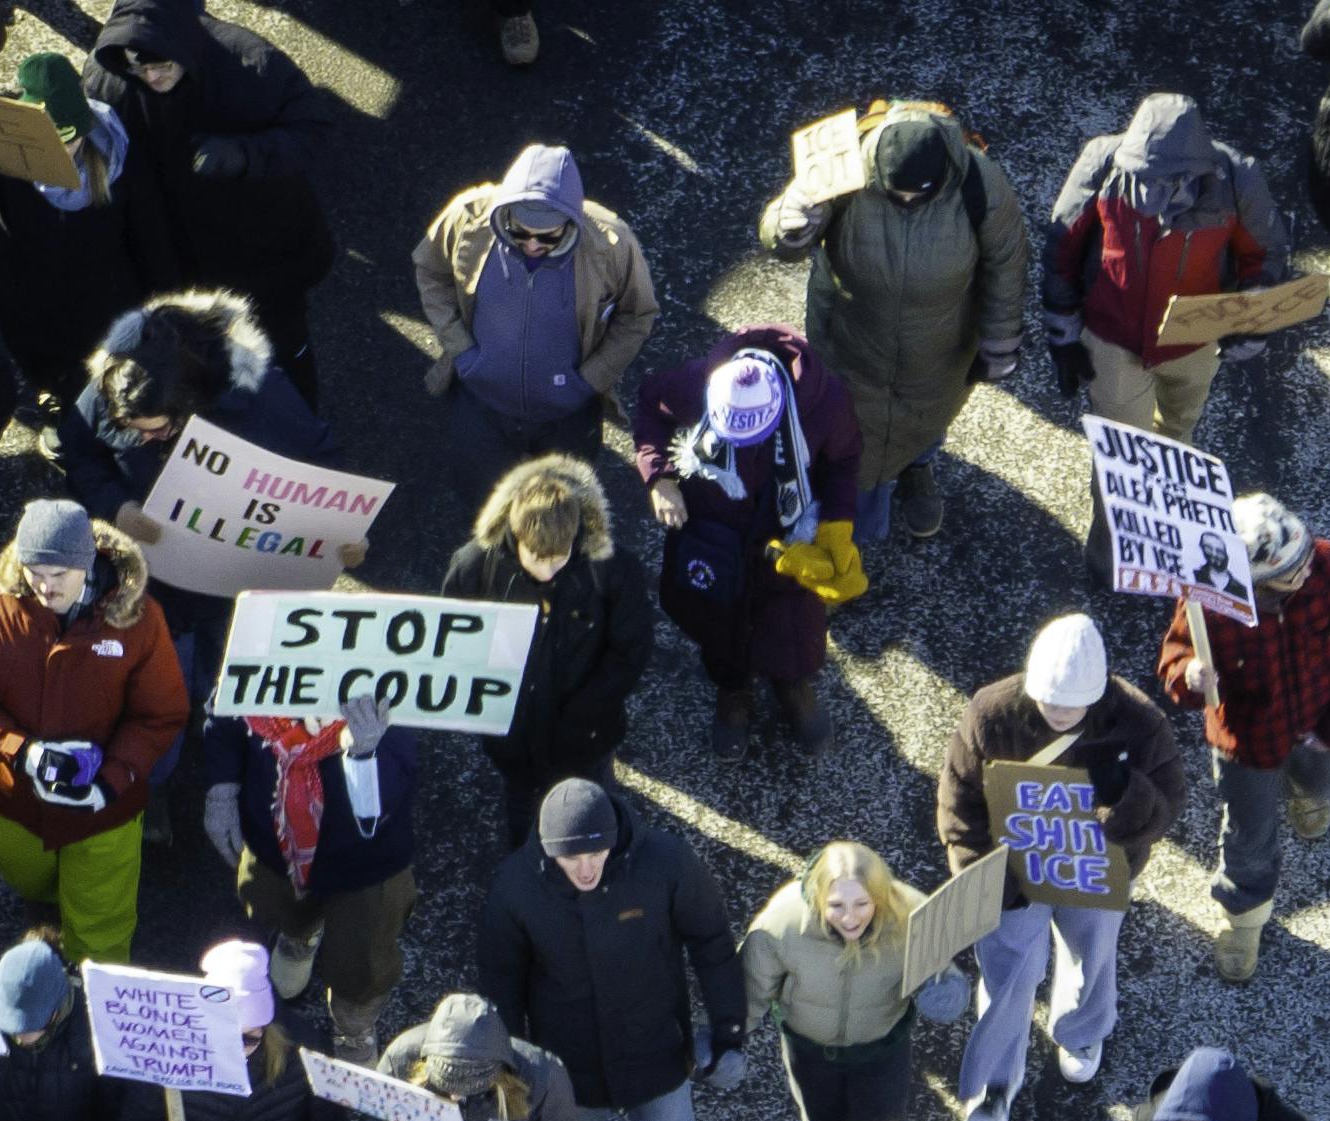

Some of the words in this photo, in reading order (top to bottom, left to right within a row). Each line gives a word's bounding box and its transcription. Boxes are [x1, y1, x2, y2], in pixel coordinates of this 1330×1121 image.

[804, 122, 846, 158] ICE
[181, 438, 231, 476] NO
[242, 467, 378, 516] HUMAN
[1097, 425, 1227, 497] JUSTICE
[242, 498, 281, 525] IS
[1106, 471, 1156, 511] ALEX
[169, 498, 326, 559] ILLEGAL
[1111, 506, 1183, 551] KILLED
[1163, 490, 1237, 535] PRETTI
[1119, 535, 1145, 566] BY
[1153, 546, 1185, 579] ICE
[281, 608, 484, 657] STOP
[227, 665, 324, 704] THE
[338, 668, 512, 716] COUP
[1017, 781, 1095, 813] EAT
[999, 813, 1108, 854] SHIT
[1025, 850, 1112, 894] ICE
[105, 1000, 208, 1031] BLONDE
[114, 985, 199, 1010] WHITE
[112, 1018, 208, 1047] WOMEN
[119, 1035, 216, 1062] AGAINST
